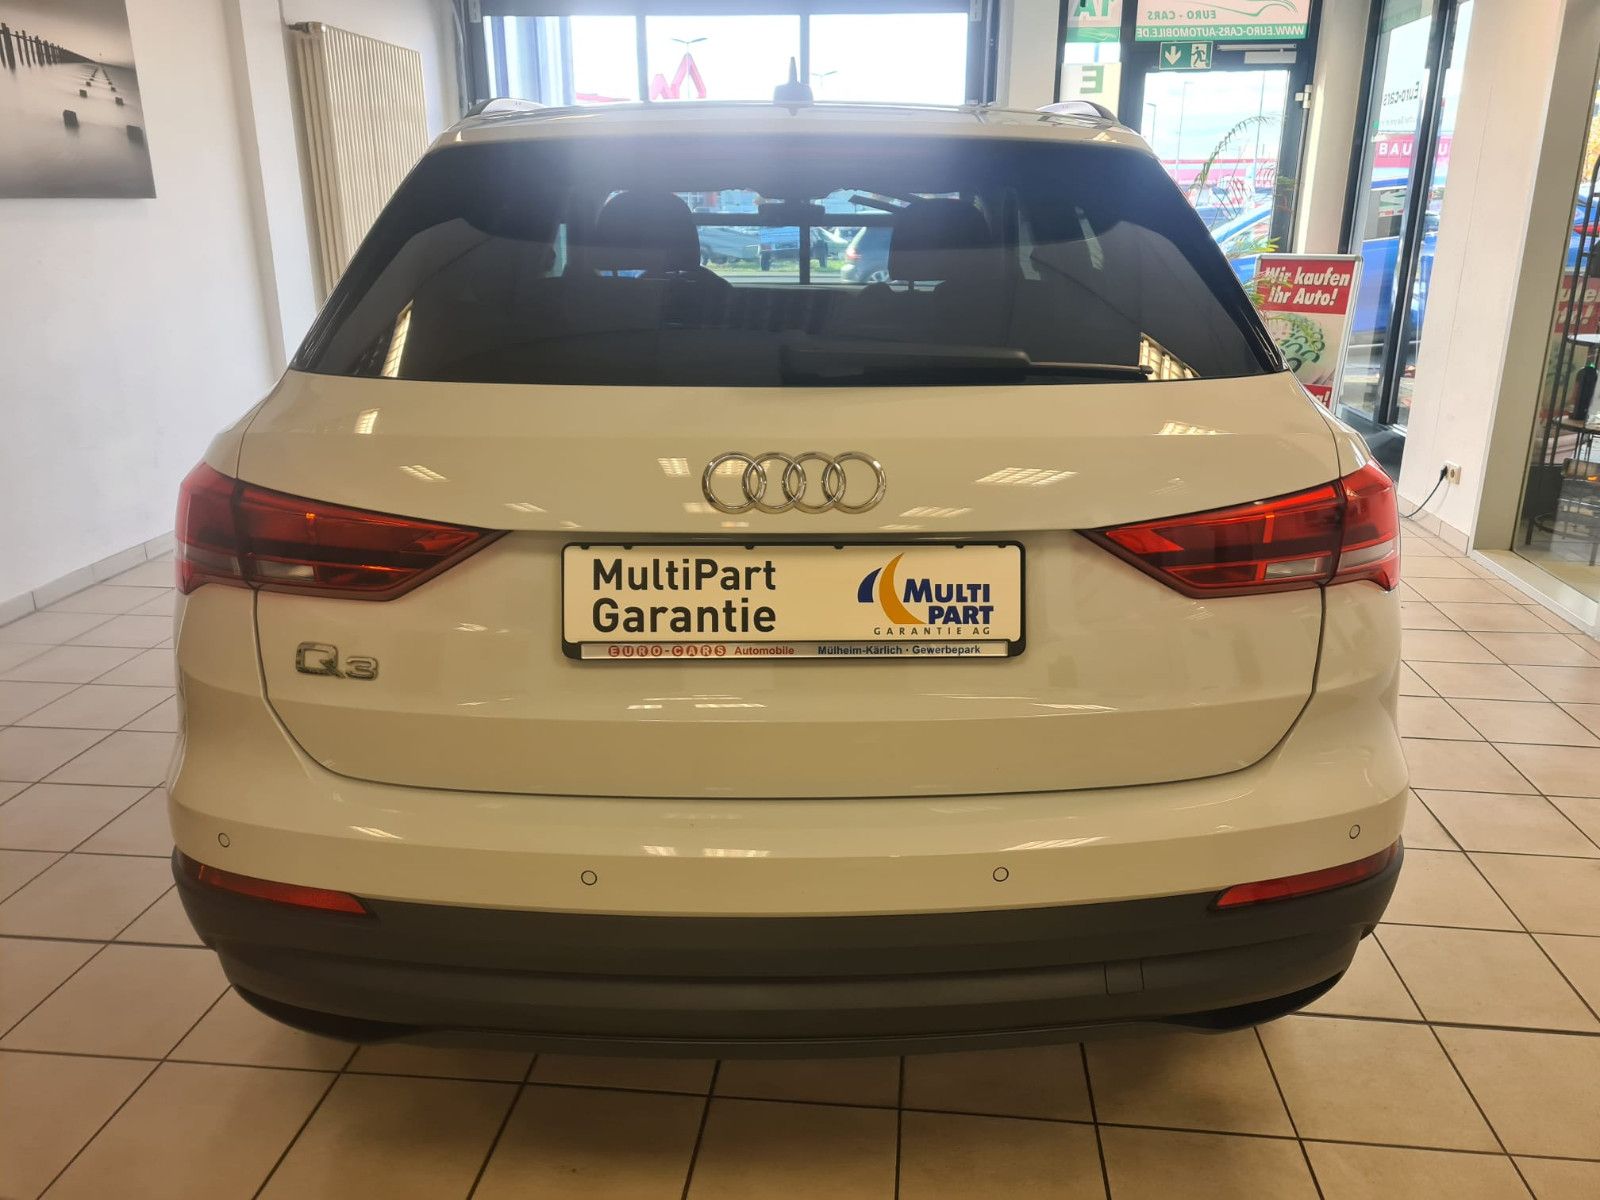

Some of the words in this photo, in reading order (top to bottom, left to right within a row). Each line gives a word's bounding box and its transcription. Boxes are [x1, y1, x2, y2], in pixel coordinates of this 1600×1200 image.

[1294, 266, 1351, 287] kaufen
[1267, 285, 1292, 304] Ihr
[1292, 287, 1339, 306] Auto!
[593, 558, 776, 591] MultiPart
[592, 597, 776, 633] Garantie
[928, 605, 994, 625] PART
[873, 626, 962, 636] GARANTIE
[972, 626, 991, 636] AG
[295, 641, 379, 681] Q3
[608, 645, 727, 657] EURO-CARS
[734, 646, 795, 656] Automobile
[818, 645, 903, 655] Mülheim-Kärlich
[912, 645, 981, 656] Gewerbepark
